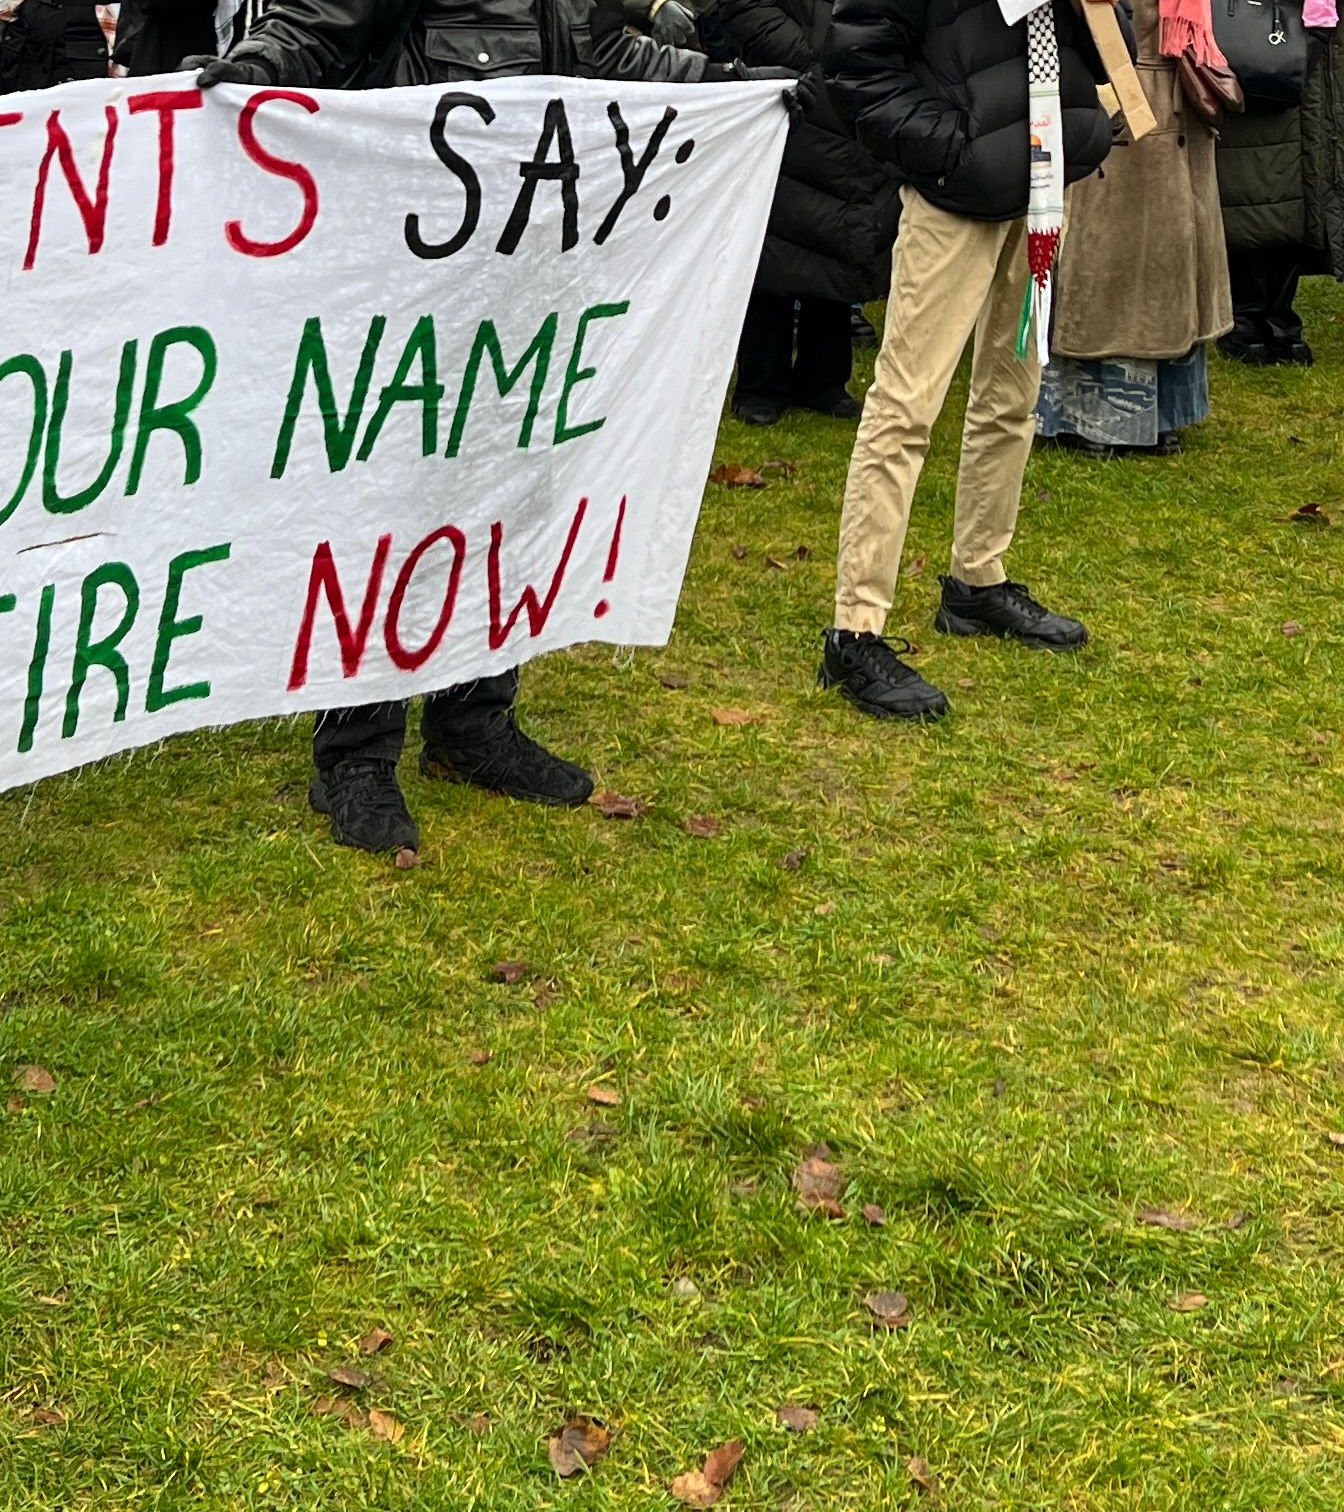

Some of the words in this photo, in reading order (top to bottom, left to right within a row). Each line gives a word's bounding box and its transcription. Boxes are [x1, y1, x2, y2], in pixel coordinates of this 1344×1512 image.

[403, 92, 696, 258] SAY:
[272, 300, 633, 481] NAME
[288, 493, 629, 694] NOW!
